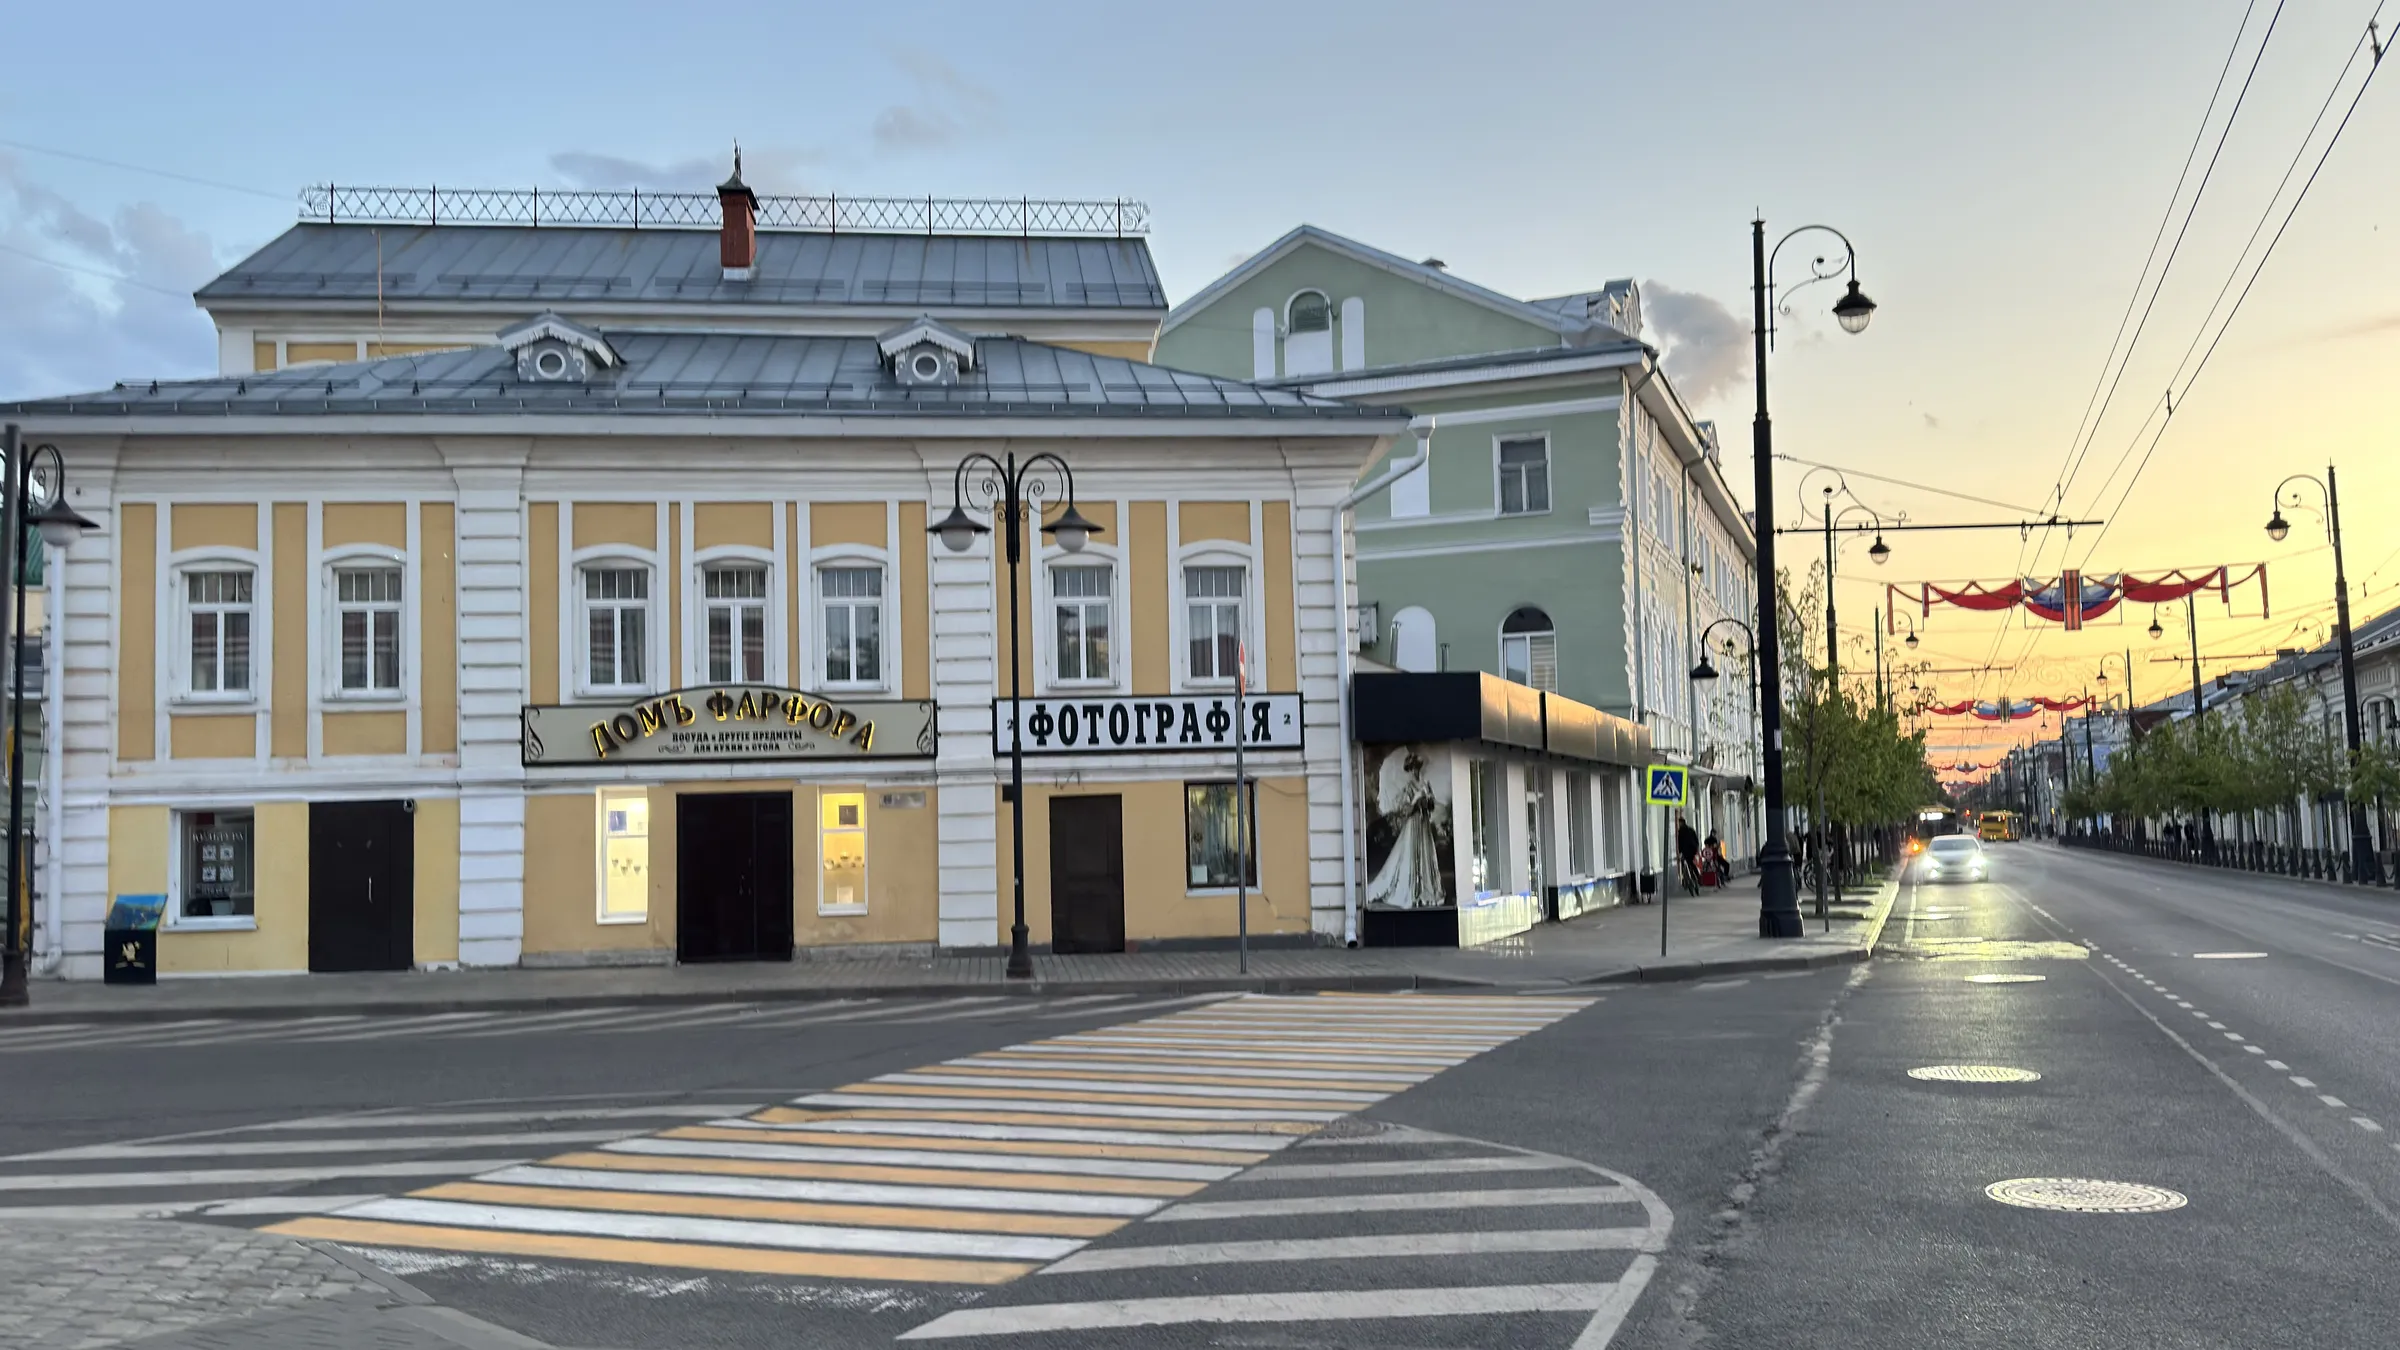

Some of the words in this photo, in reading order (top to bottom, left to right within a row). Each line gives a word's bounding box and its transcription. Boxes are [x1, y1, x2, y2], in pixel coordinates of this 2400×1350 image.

[590, 694, 696, 758] ДОМЪ
[706, 688, 875, 752] ФАРФОРА
[1283, 713, 1291, 725] 2
[672, 731, 709, 743] ПОСУДА
[752, 729, 803, 742] ПРЕДМЕТЫ
[693, 743, 711, 754] ДЛЯ
[713, 743, 743, 753] КУХНИ
